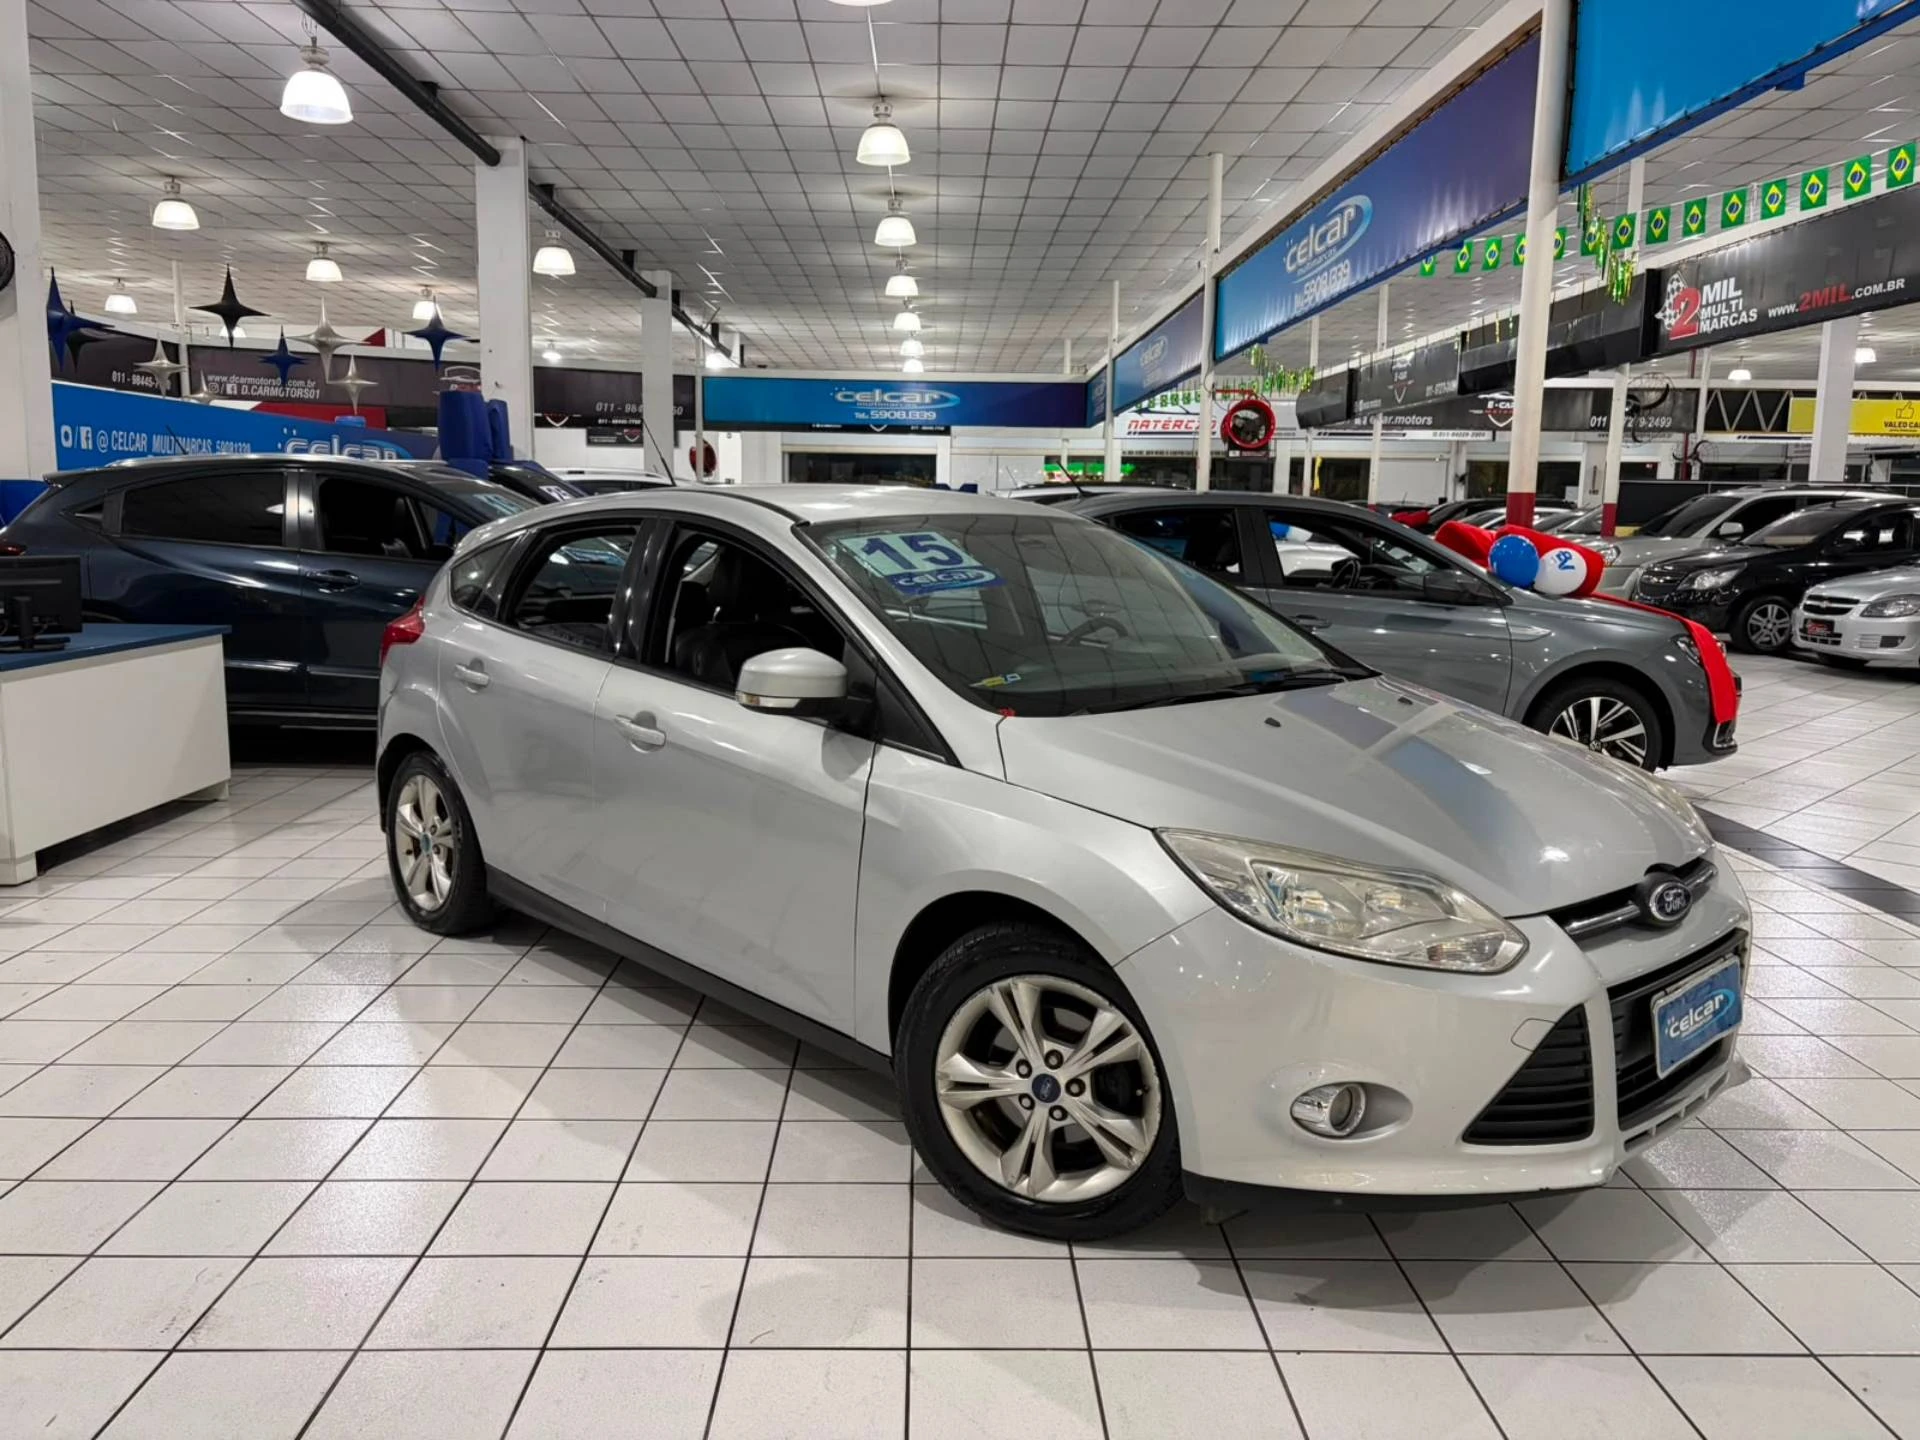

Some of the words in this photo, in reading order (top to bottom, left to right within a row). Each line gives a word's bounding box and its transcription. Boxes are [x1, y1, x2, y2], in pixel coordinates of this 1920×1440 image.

[1286, 206, 1355, 273] celcar
[1668, 287, 1701, 340] 2
[1702, 277, 1742, 306] MIL
[1701, 298, 1743, 320] MULTI
[1699, 308, 1758, 334] MARCAS
[207, 374, 316, 388] www.dcarmotors0.com.br
[834, 388, 940, 403] celcar
[1128, 417, 1217, 430] NATÉRC
[1590, 416, 1608, 428] 011
[861, 534, 964, 570] 15
[899, 571, 978, 586] celcar
[1668, 993, 1725, 1039] celcar
